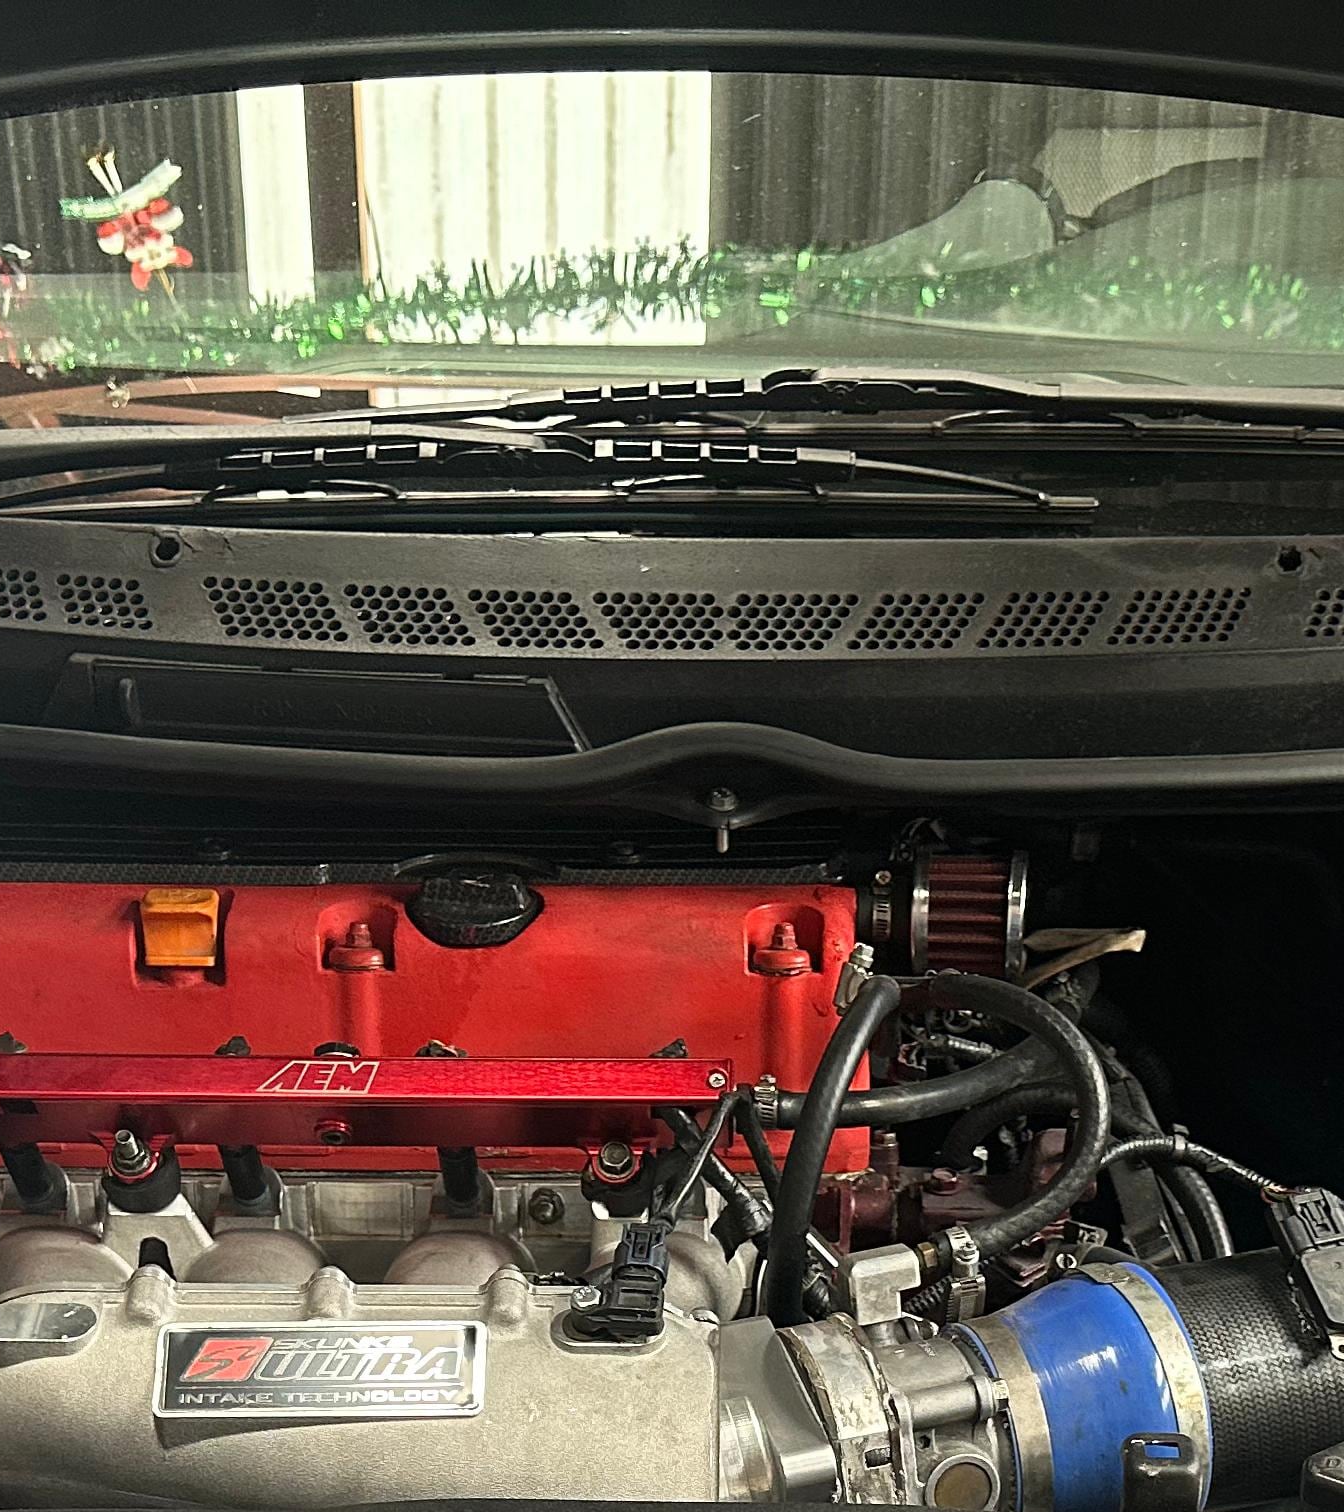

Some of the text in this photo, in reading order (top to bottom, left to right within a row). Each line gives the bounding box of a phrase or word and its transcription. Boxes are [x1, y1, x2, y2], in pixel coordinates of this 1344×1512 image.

[256, 1060, 380, 1095] AEM
[254, 1346, 463, 1381] ULTRA
[178, 1389, 459, 1405] INTAKE TECHNOLOGY
